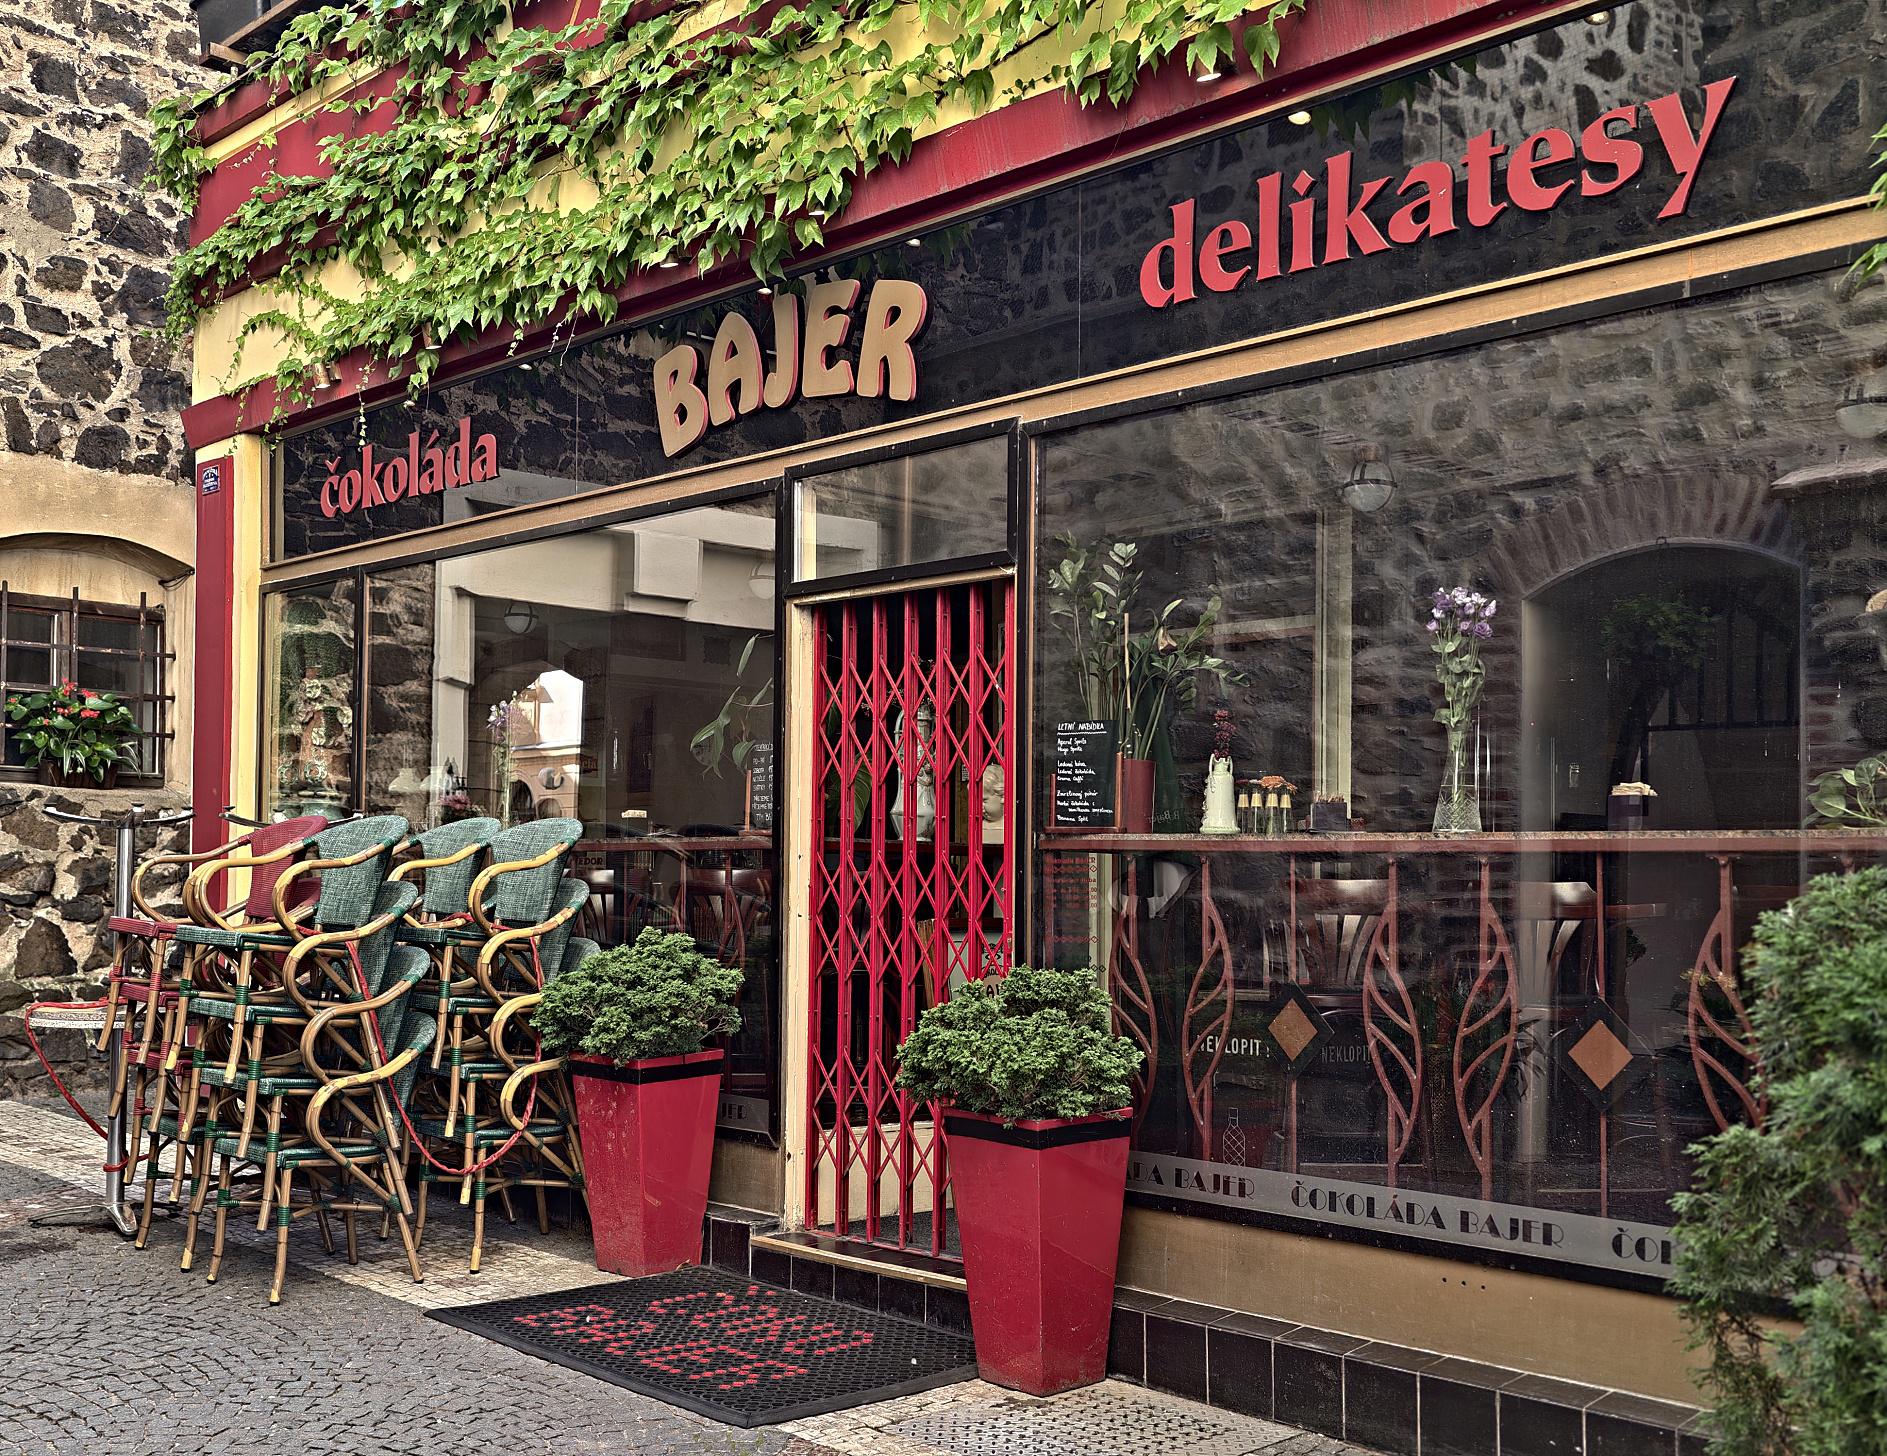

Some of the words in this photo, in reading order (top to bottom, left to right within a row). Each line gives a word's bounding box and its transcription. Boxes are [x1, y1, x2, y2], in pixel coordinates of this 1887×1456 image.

[1139, 75, 1737, 309] delikatesy
[653, 279, 929, 459] BAJER
[320, 416, 500, 519] čokoláda
[1057, 721, 1075, 731] LETNÍ
[1078, 721, 1104, 731] NABÍDKA
[1174, 1167, 1255, 1201] BAJER
[1290, 1180, 1447, 1230] ČOKOLÁDA
[1459, 1210, 1565, 1249] BAJER
[512, 1303, 808, 1389] BAJER
